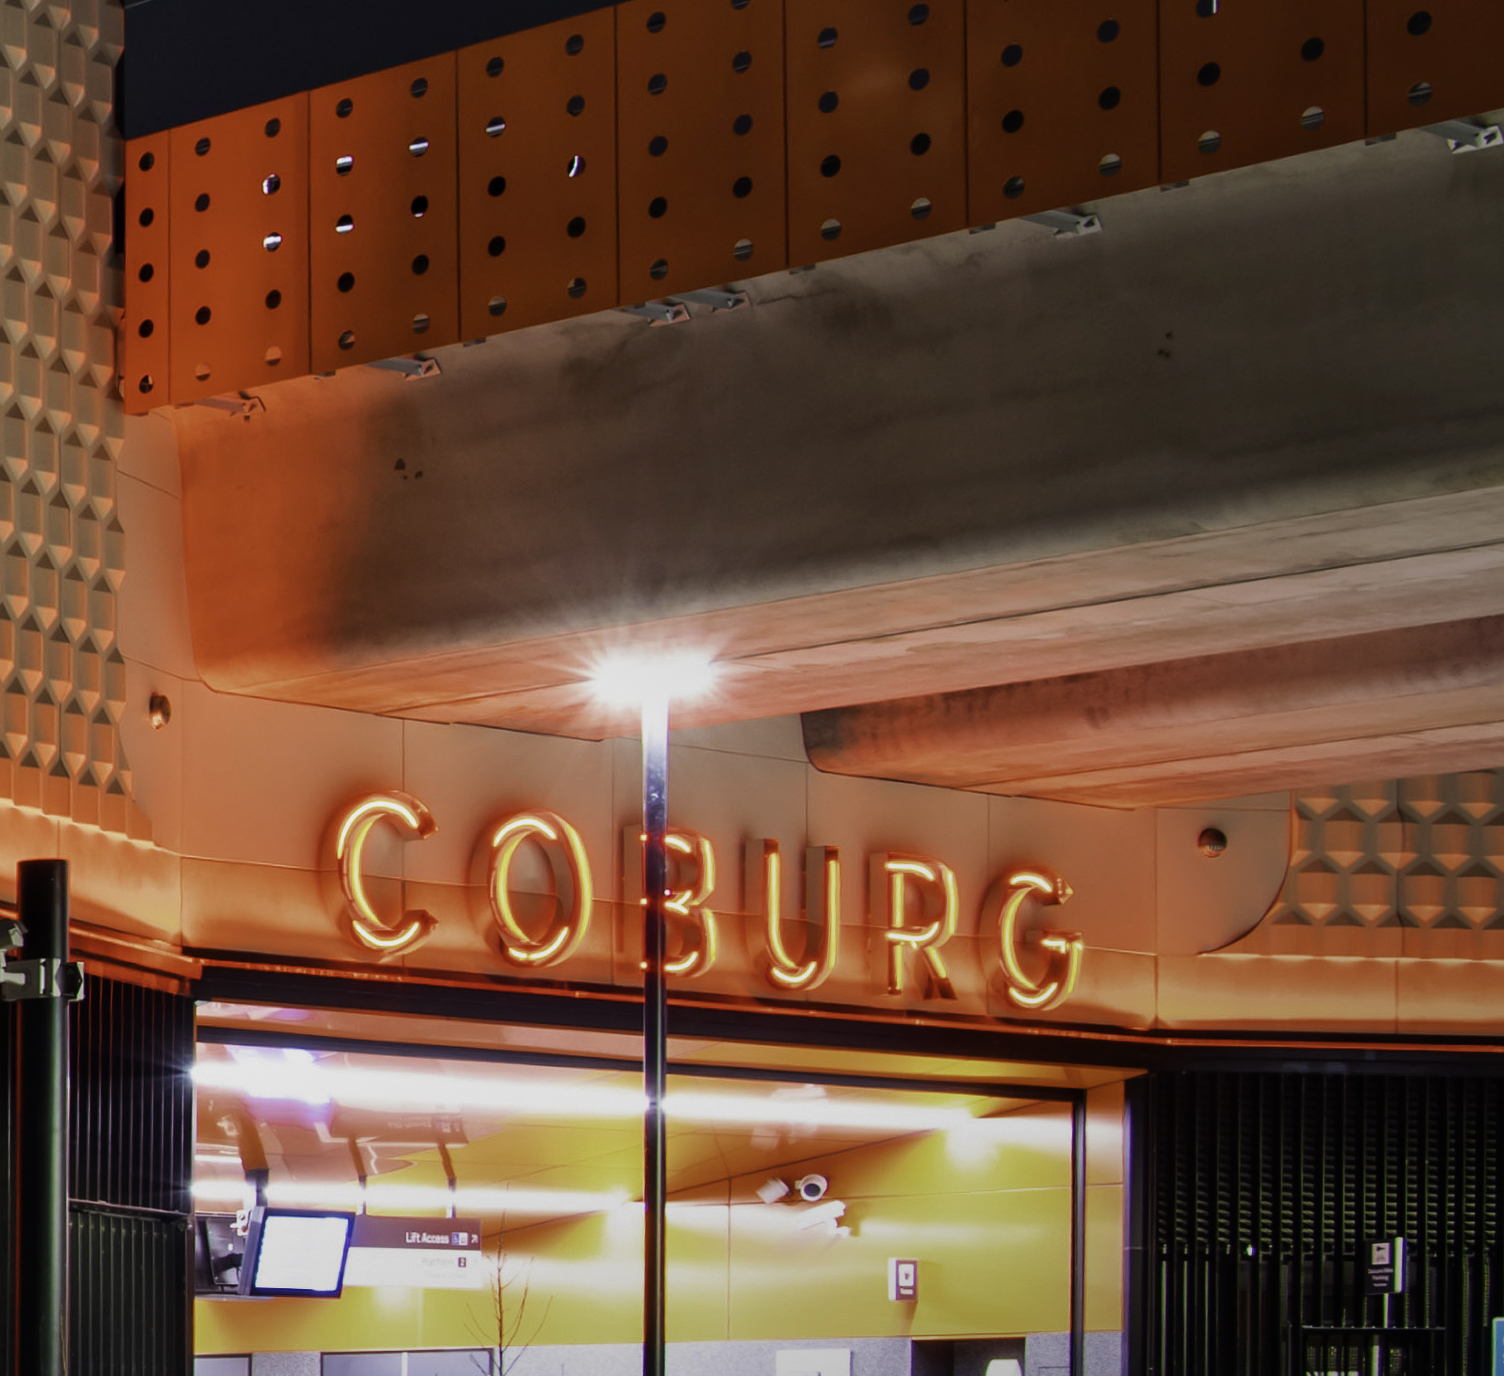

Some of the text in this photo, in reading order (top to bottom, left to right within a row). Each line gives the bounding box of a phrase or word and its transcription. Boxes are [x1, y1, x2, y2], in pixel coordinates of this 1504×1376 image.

[335, 791, 1083, 1012] COBURG
[405, 1232, 450, 1244] Lift Access
